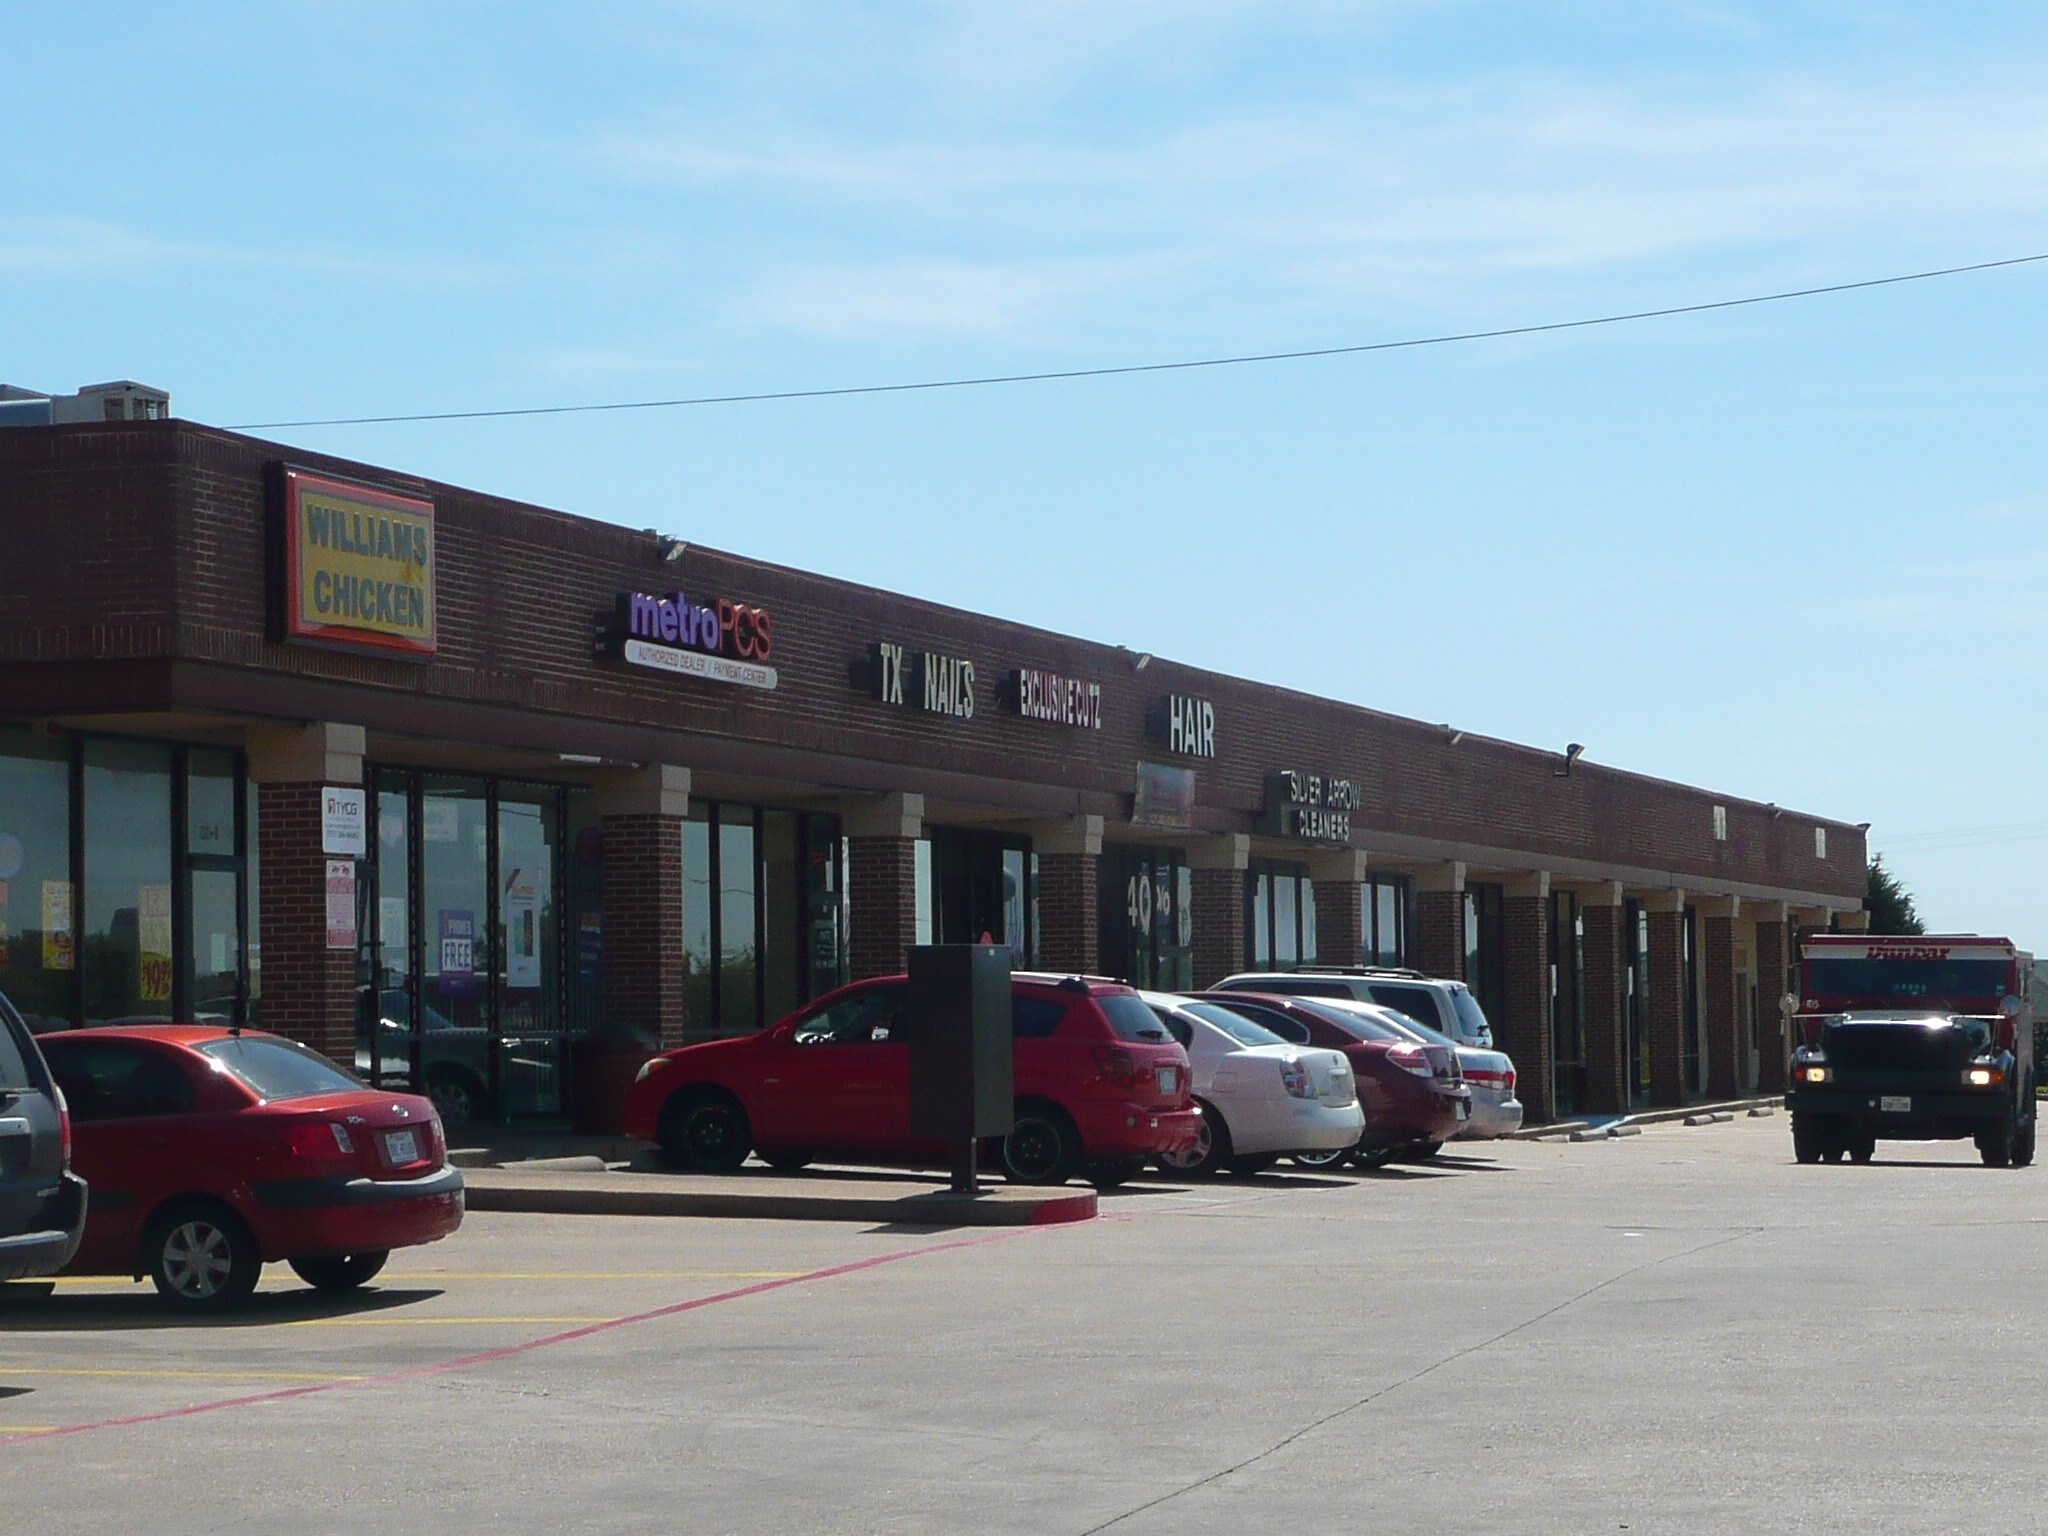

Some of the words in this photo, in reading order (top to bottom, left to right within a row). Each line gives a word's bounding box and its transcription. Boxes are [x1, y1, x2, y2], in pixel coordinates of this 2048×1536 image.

[307, 504, 427, 566] WILLIAMS
[313, 570, 424, 629] CHICKEN
[631, 591, 771, 661] metroPCS
[638, 645, 679, 667] AUTHORIZED
[680, 654, 705, 672] DEALER
[714, 661, 742, 679] PAYMENT
[743, 668, 767, 685] CENTER
[880, 643, 902, 704] TX
[924, 652, 974, 719] NAILS
[1020, 669, 1074, 724] EXCLUSIVE
[1075, 680, 1101, 729] CUTZ
[1170, 694, 1215, 758] HAIR
[1327, 778, 1361, 811] ARROW
[1299, 809, 1350, 842] CLEANERS
[444, 942, 470, 968] FREE
